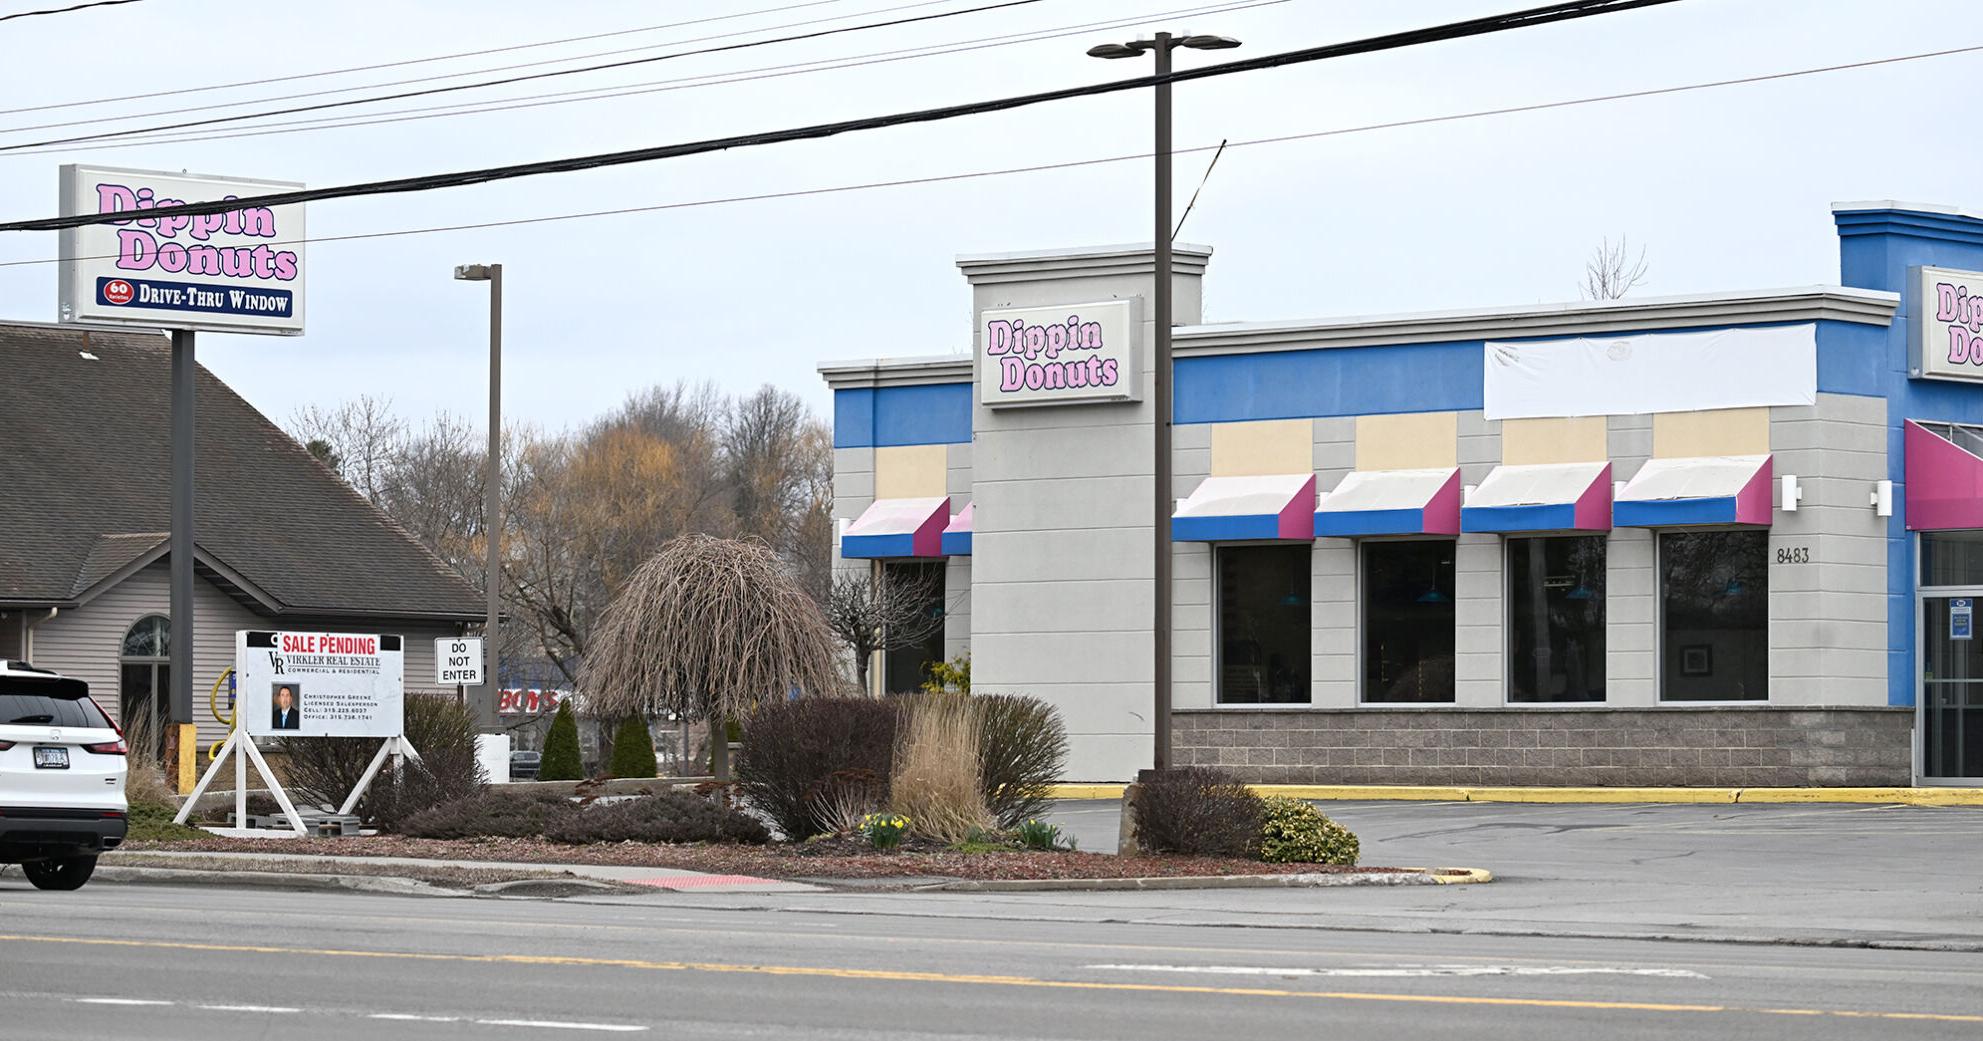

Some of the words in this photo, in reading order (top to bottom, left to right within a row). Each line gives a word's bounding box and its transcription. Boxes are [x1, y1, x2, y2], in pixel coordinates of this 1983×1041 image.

[116, 229, 297, 281] Donuts
[110, 282, 128, 294] 60
[139, 283, 224, 308] DRIVE-THRU
[229, 289, 289, 312] WINDOW
[987, 314, 1103, 360] Dippin
[1000, 354, 1118, 393] Donuts
[1777, 547, 1809, 563] 8483
[283, 635, 315, 653] SALE
[320, 636, 375, 655] PENDING
[452, 643, 467, 653] DO
[286, 655, 325, 665] VIRKLER
[326, 656, 348, 666] REAL
[350, 657, 381, 667] ESTATE
[449, 656, 470, 666] NOT
[442, 670, 476, 680] ENTER
